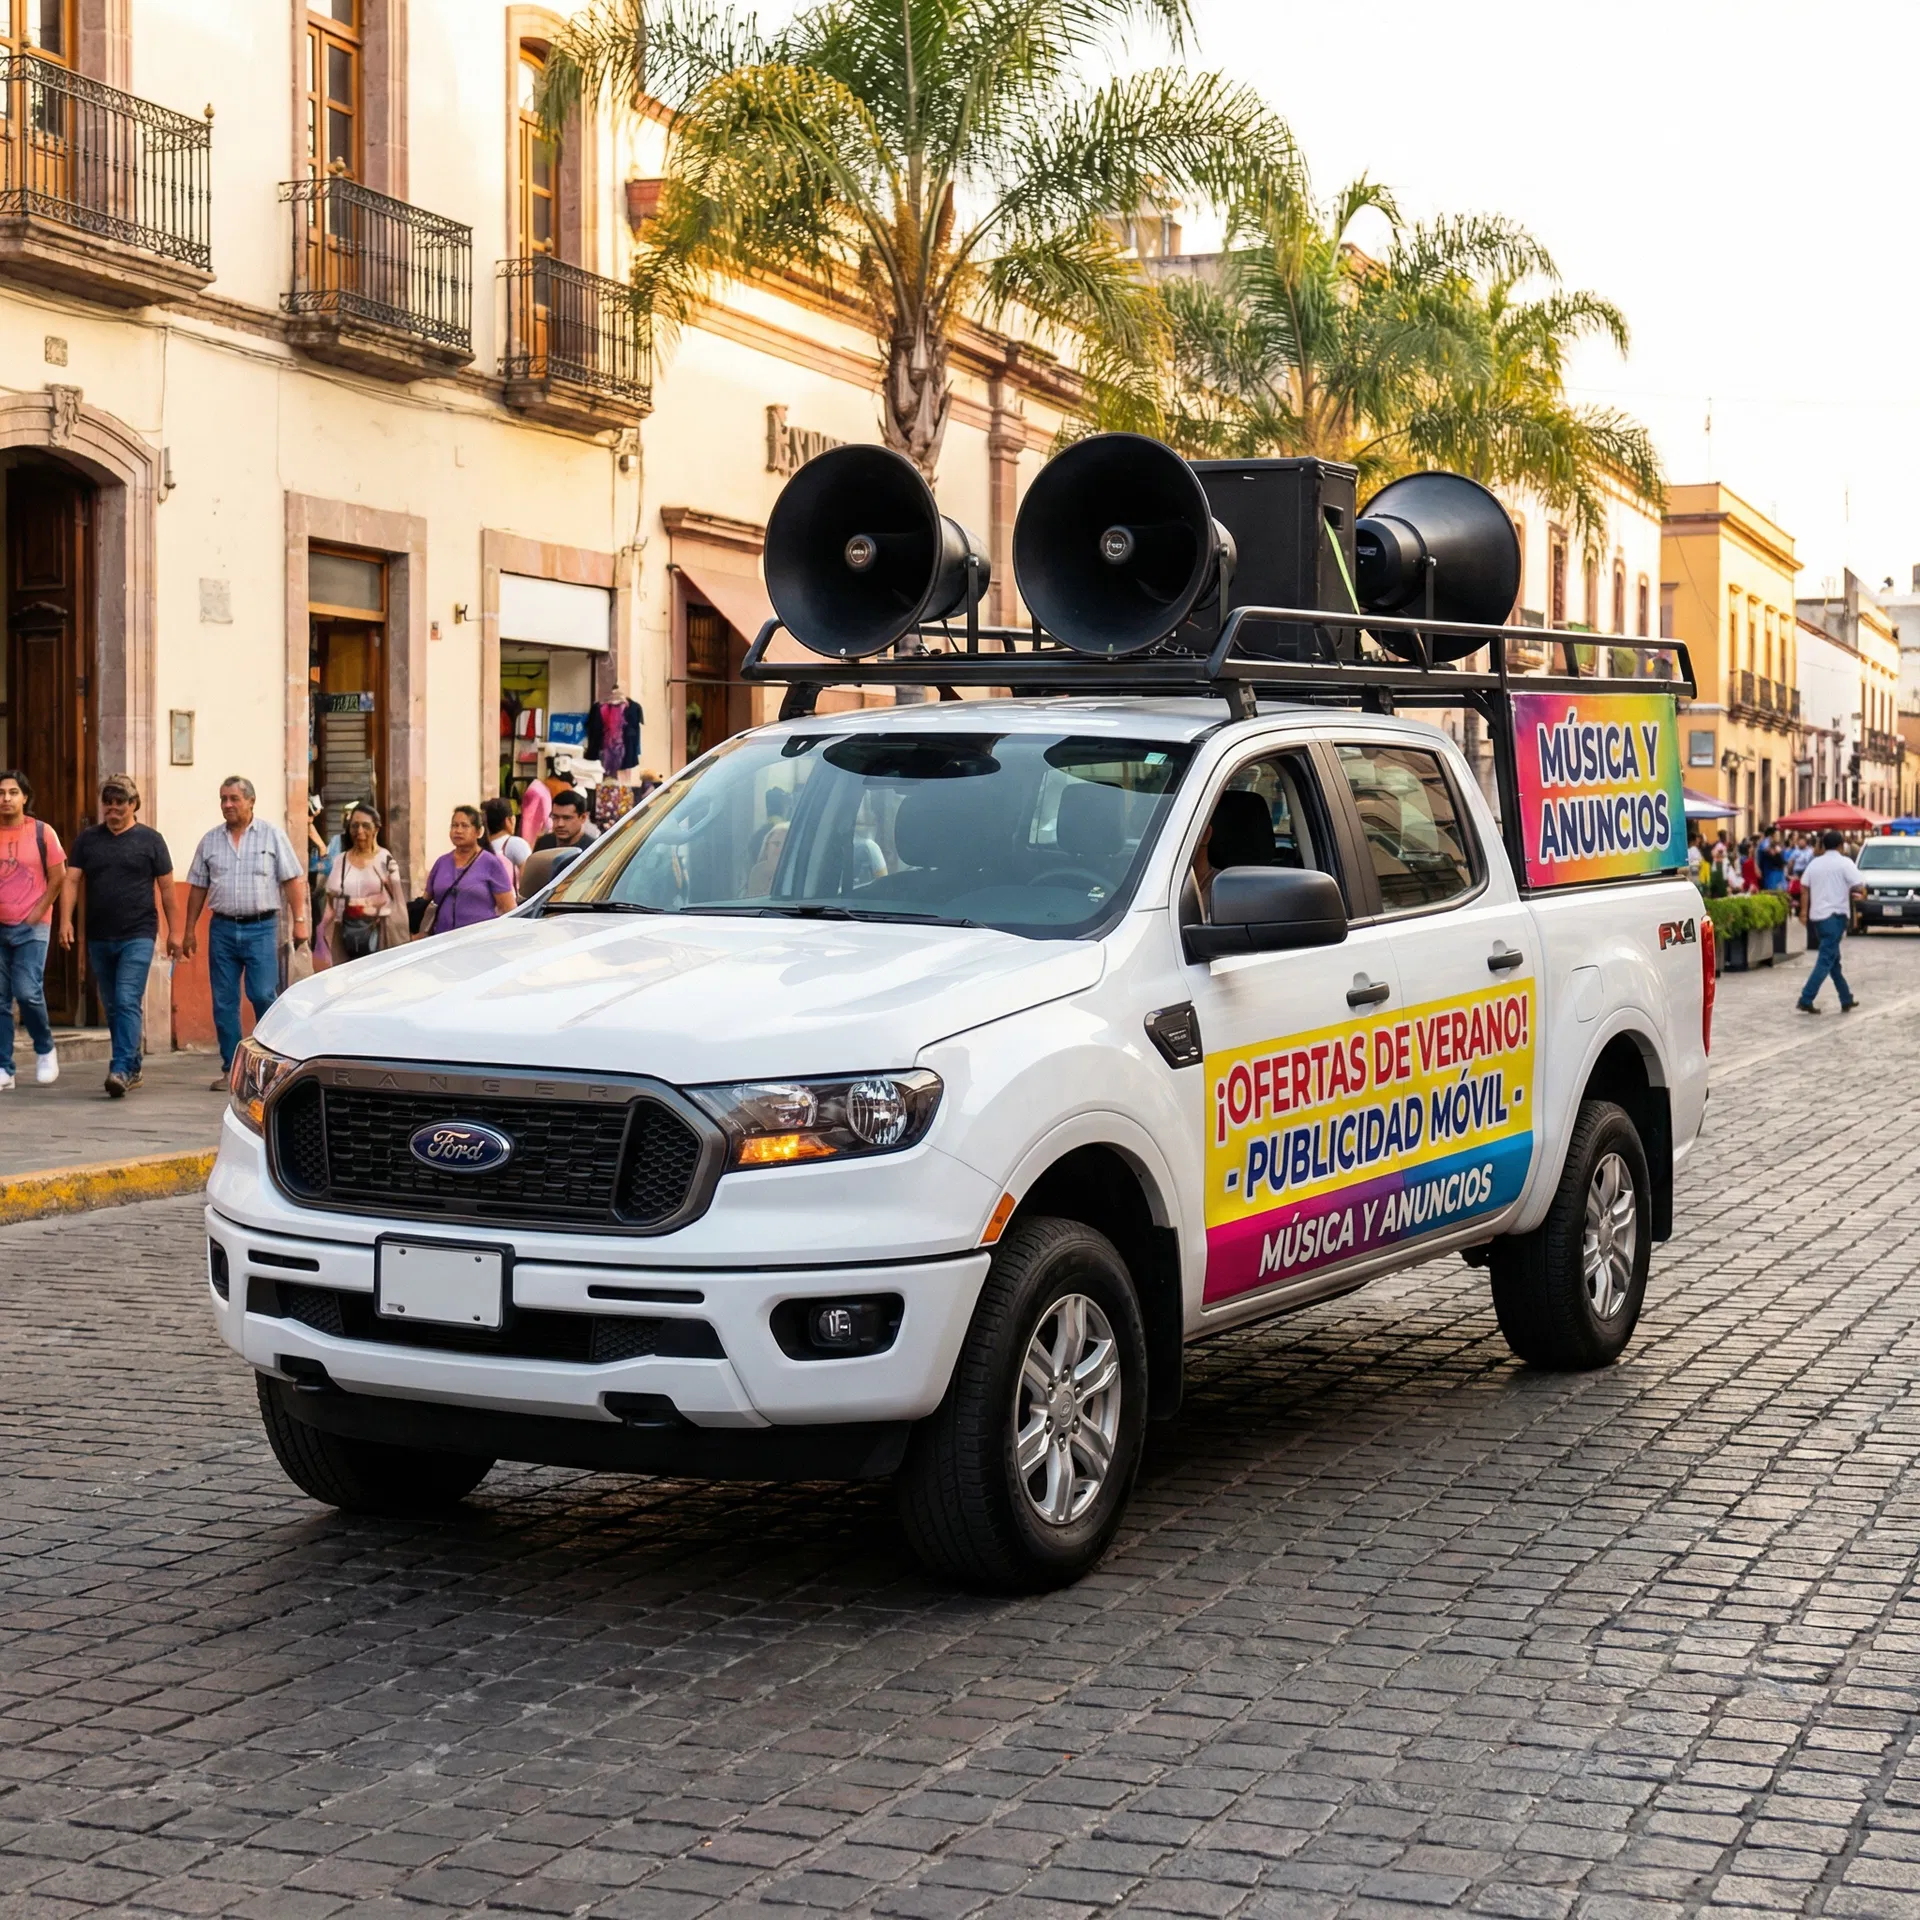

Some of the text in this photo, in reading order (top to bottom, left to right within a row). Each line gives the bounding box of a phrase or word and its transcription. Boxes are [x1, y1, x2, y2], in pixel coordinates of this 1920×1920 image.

[1538, 711, 1659, 784] MÚSICA Y
[1540, 792, 1671, 860] ANUNCIOS
[1658, 917, 1697, 951] FX4
[332, 1069, 609, 1099] RANGER
[1216, 994, 1529, 1143] ¡OFERTAS DE VERANO!
[427, 1129, 487, 1161] Ford
[1245, 1095, 1424, 1199] PUBLICIDAD
[1429, 1067, 1509, 1142] MÓVIL
[1258, 1163, 1495, 1279] MÚSICA Y ANUNCIOS
